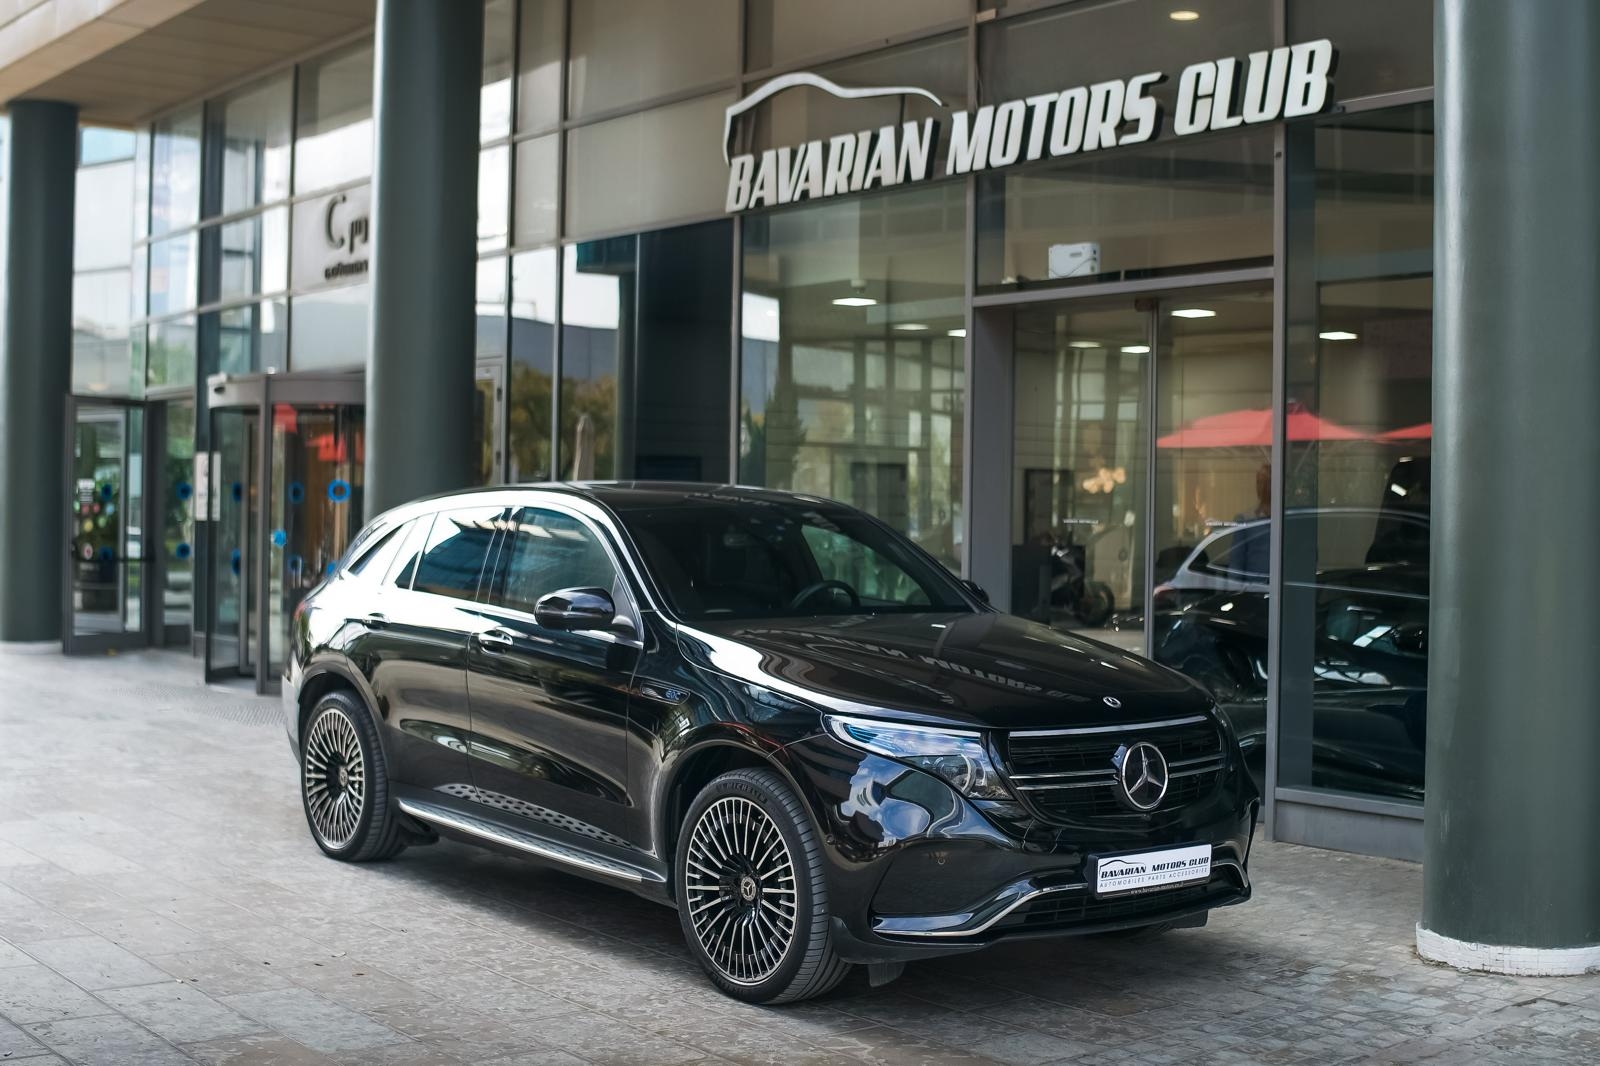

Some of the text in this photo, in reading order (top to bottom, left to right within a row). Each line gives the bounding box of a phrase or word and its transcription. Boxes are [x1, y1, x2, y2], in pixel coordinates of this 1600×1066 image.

[725, 39, 1334, 213] BAVARIAN MOTORS CLUB
[1101, 857, 1209, 878] BAVARIAN MOTORS CLUB
[1100, 878, 1145, 888] AUTOMOBILES
